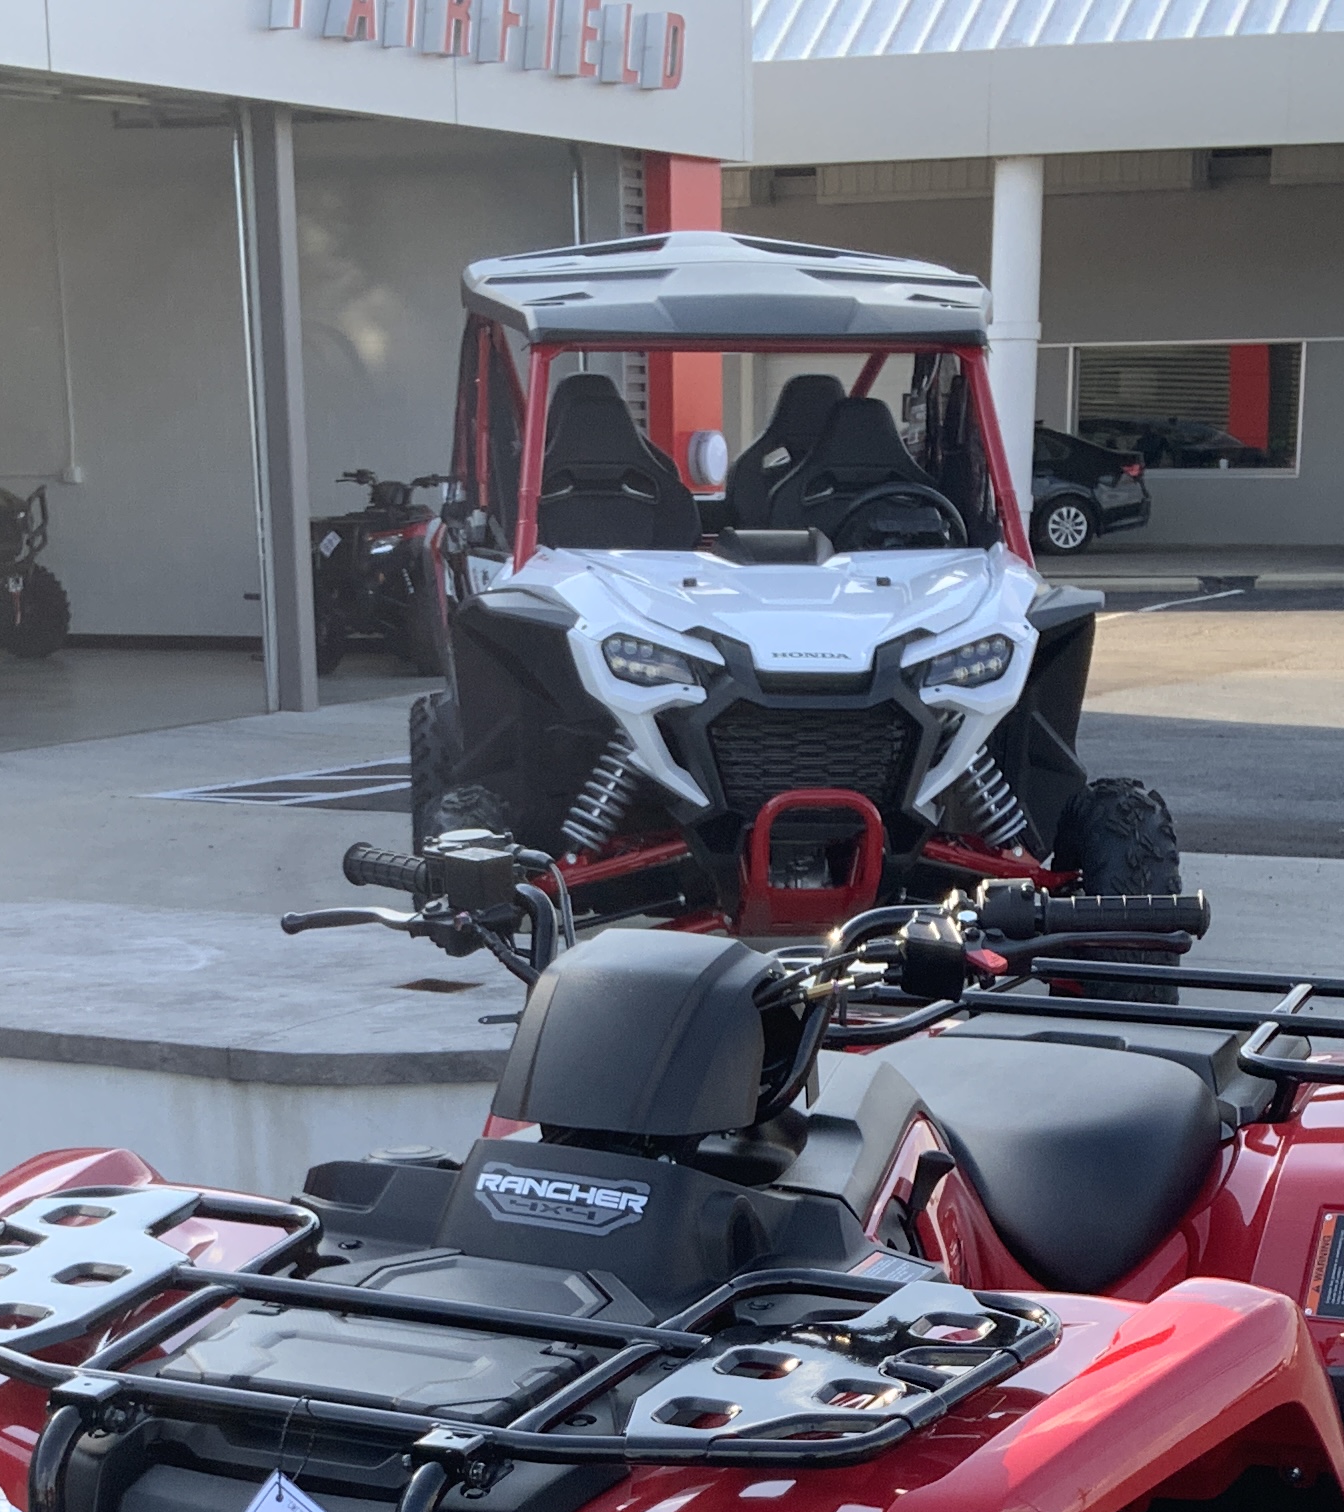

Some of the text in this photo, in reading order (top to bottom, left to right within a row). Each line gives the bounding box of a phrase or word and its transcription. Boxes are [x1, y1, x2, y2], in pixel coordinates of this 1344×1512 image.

[771, 651, 852, 660] HONDA
[475, 1172, 649, 1214] RANCHER
[1313, 1235, 1332, 1282] WARNING
